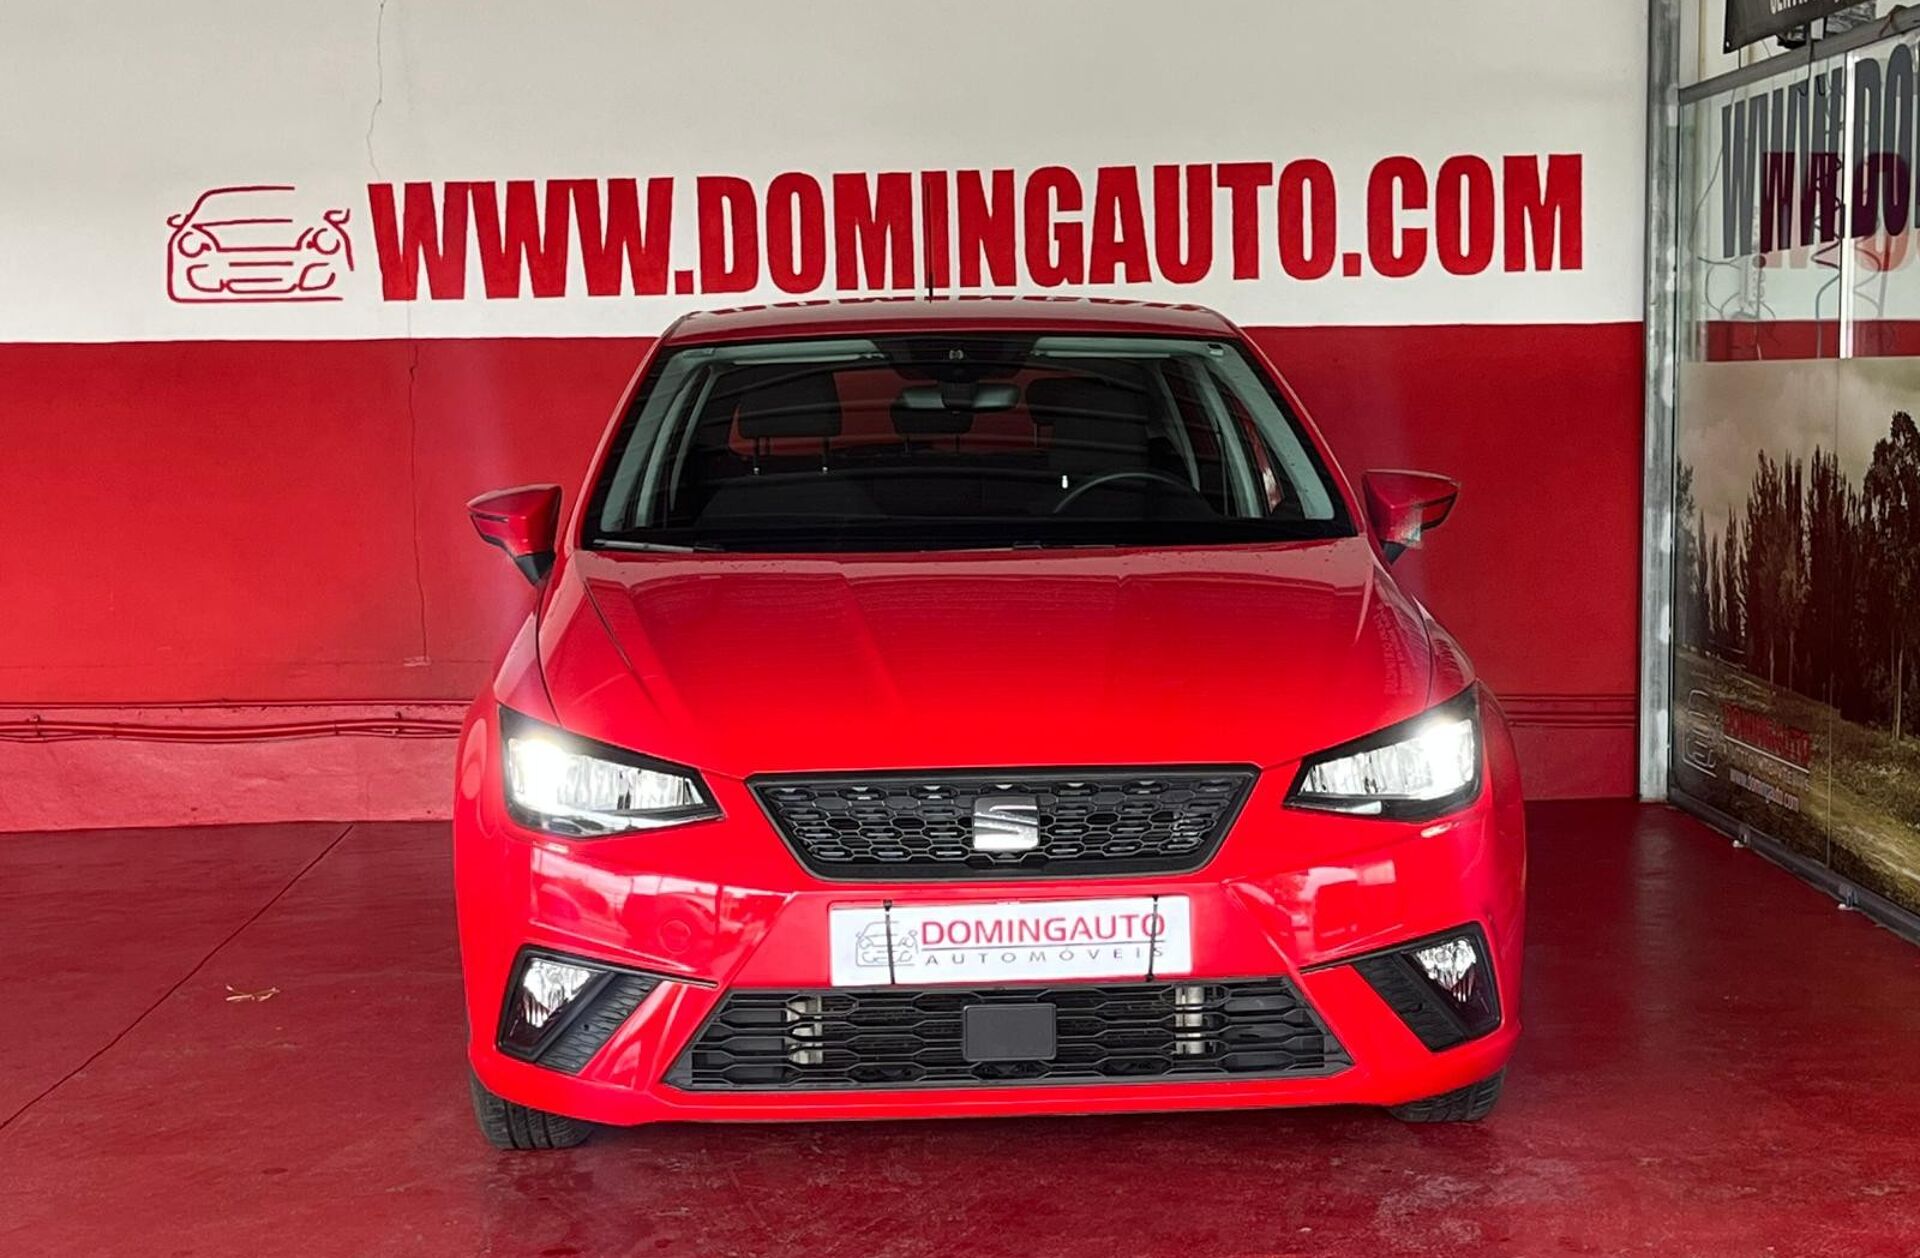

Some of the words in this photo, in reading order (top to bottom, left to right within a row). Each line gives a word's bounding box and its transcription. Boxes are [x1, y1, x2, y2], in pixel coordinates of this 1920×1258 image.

[368, 154, 1584, 301] WWW.DOMINGAUTO.COM
[921, 913, 1166, 946] DOMINGAUTO
[924, 946, 1165, 966] AUTOMÓVEIS
